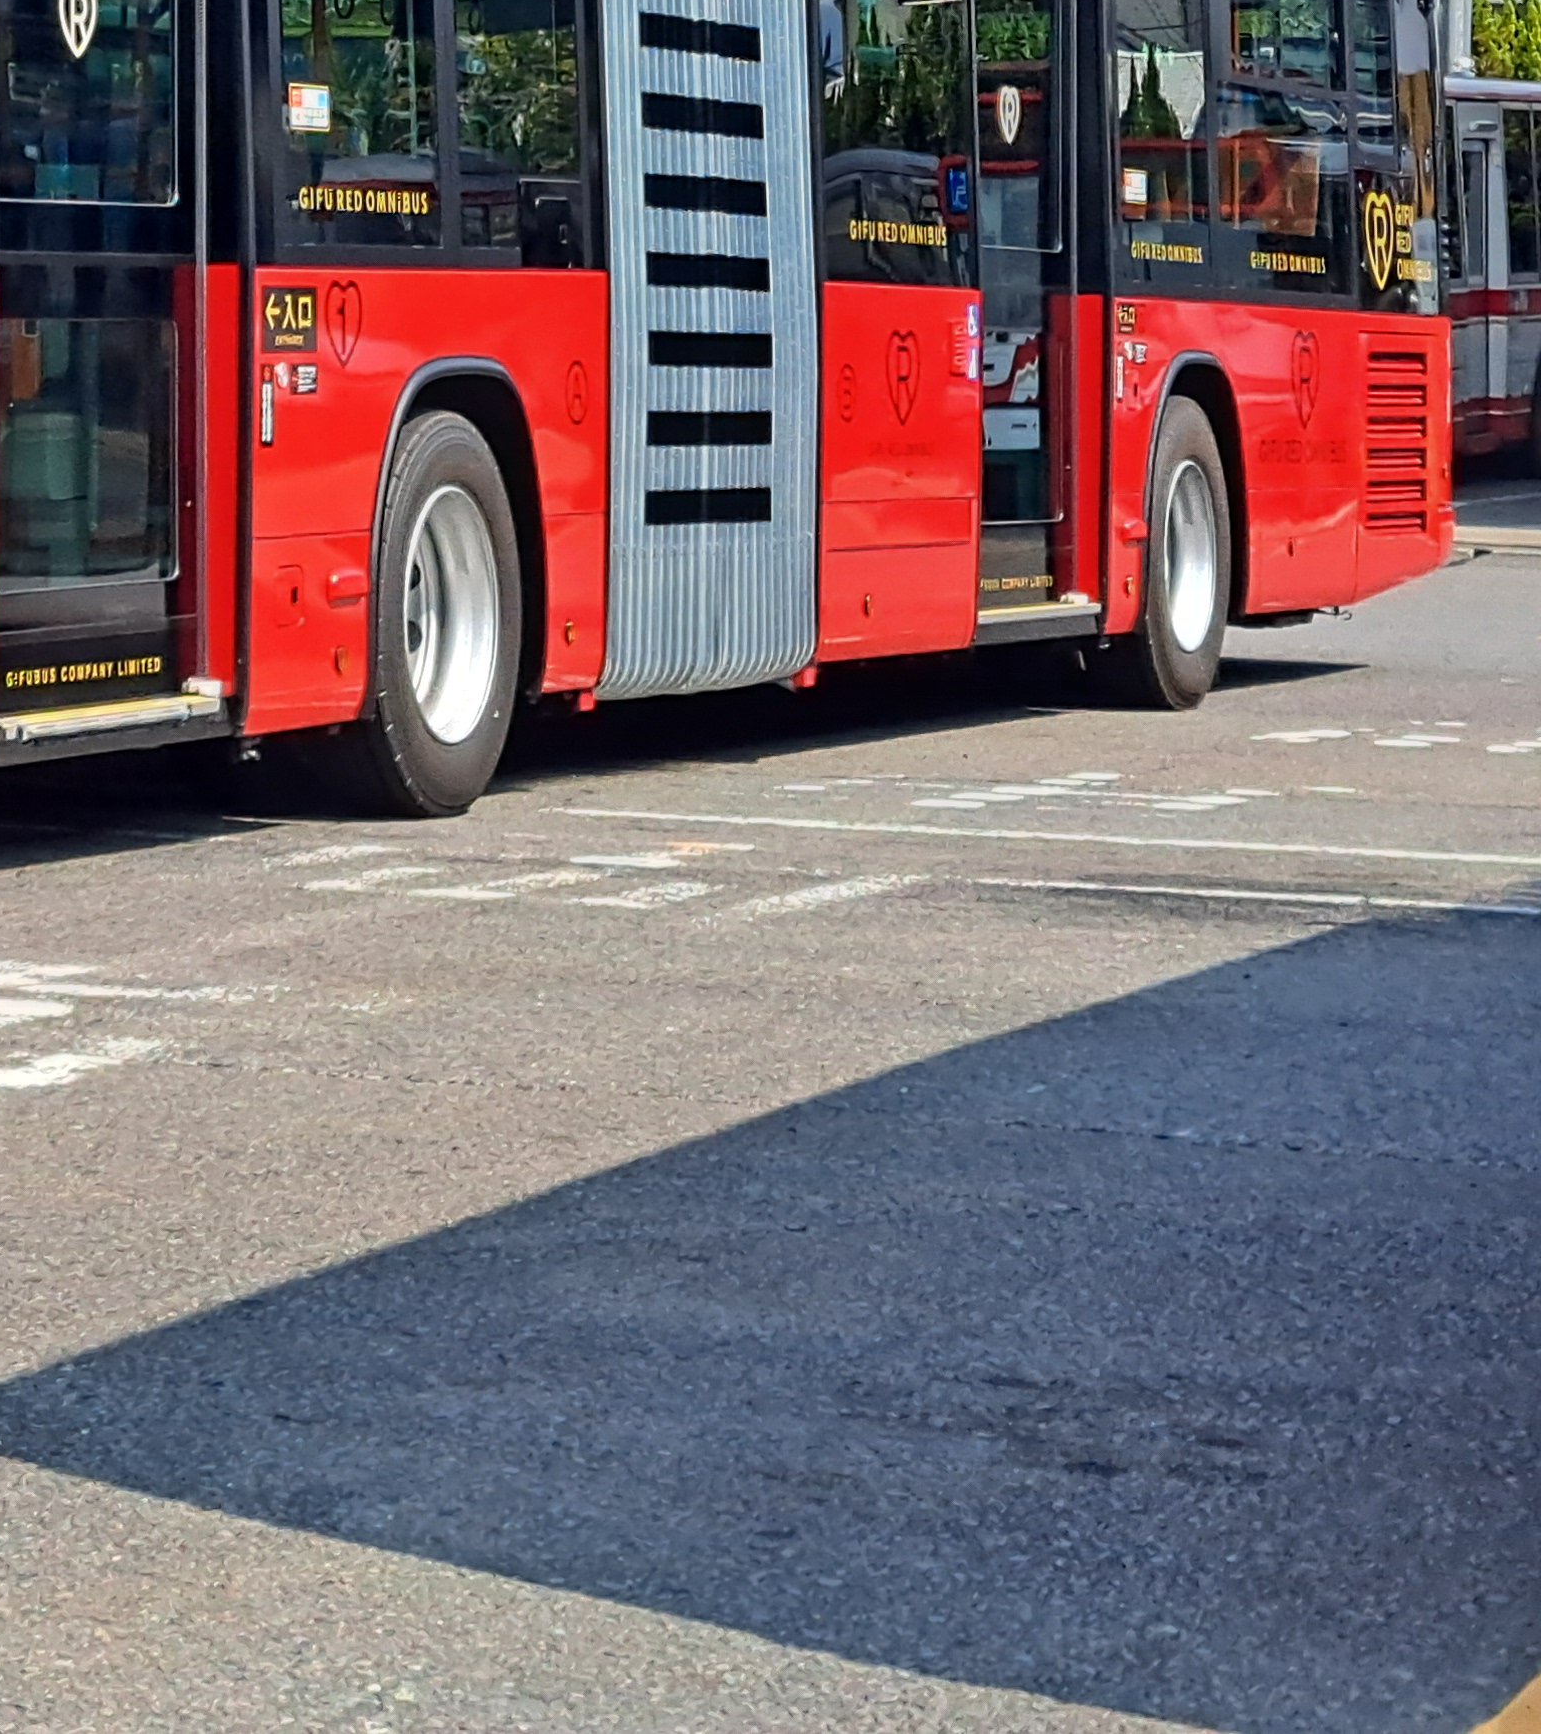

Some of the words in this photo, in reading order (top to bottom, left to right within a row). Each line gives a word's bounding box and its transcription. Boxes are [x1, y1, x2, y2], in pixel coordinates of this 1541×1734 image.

[335, 189, 363, 214] RED
[848, 219, 875, 243] GIFU
[281, 292, 314, 332] 入口
